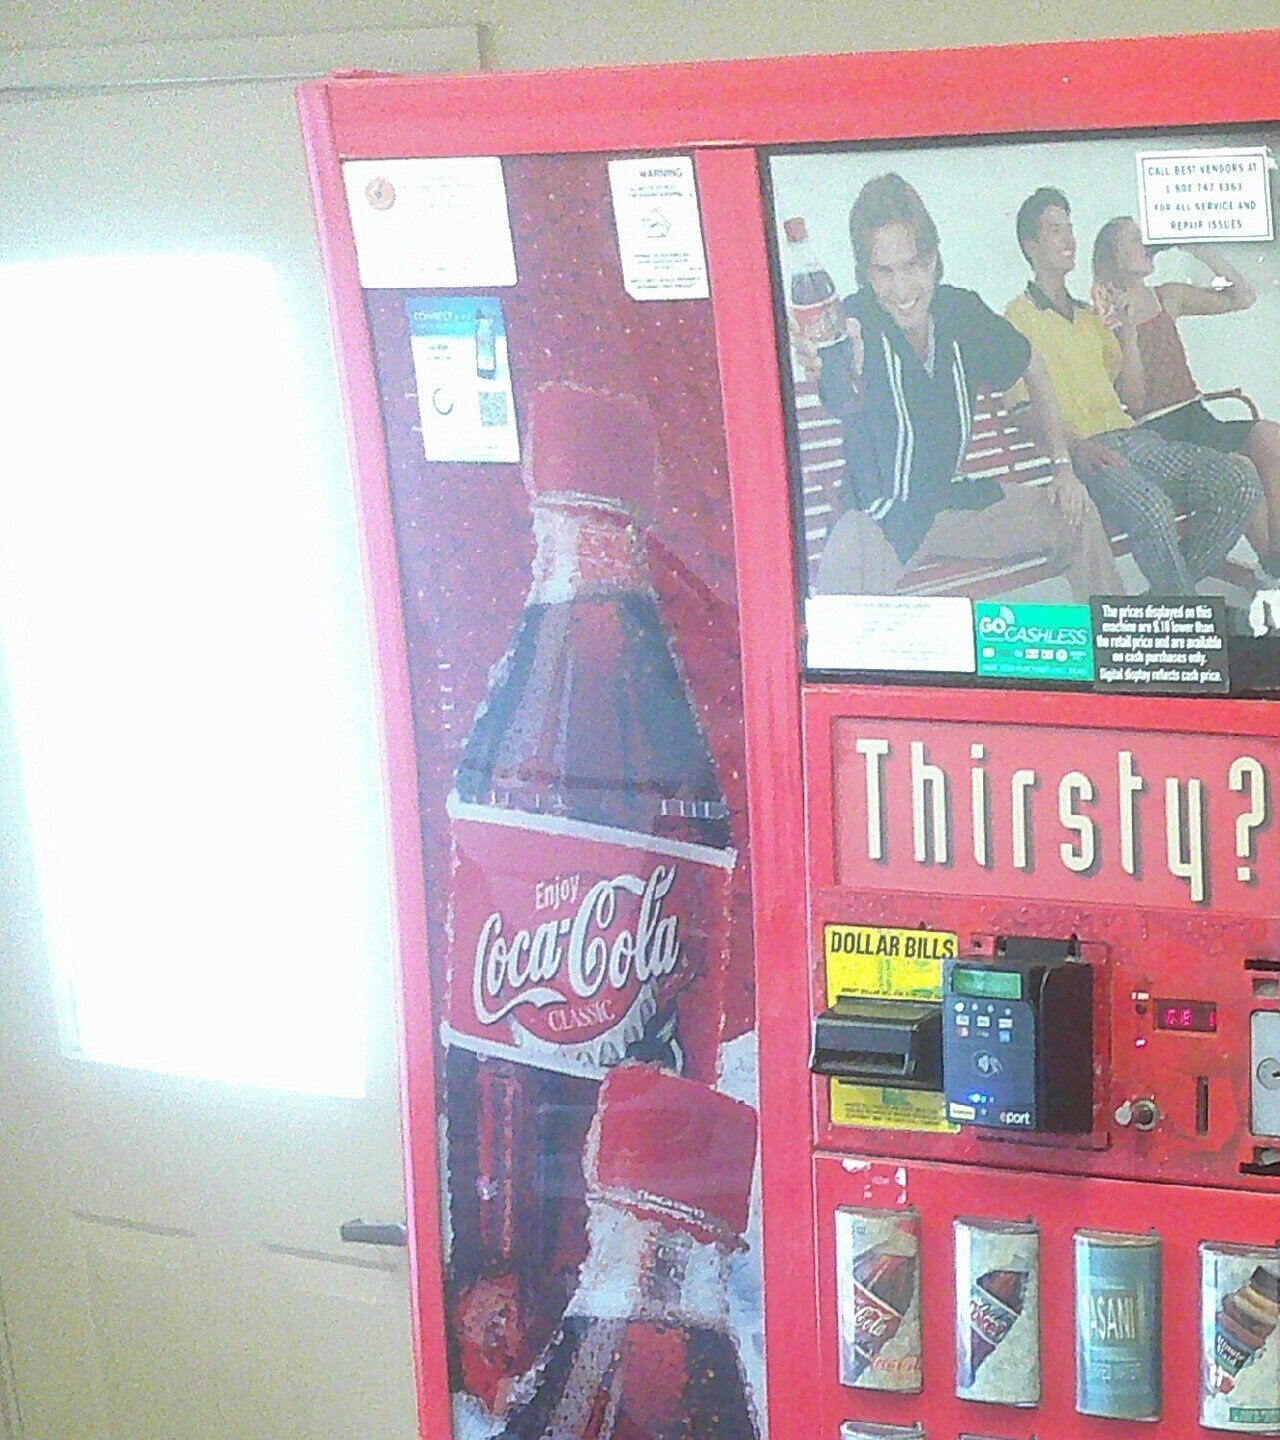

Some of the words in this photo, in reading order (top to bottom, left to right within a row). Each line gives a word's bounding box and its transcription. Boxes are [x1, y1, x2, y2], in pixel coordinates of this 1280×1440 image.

[1148, 167, 1169, 175] CALL
[1174, 165, 1196, 175] BEST
[1200, 164, 1244, 174] VENDORS
[1239, 201, 1256, 209] AND
[1171, 221, 1202, 230] REPAIR
[1208, 220, 1242, 228] ISSUES
[979, 616, 1006, 633] GO
[1005, 626, 1087, 646] CASHLESS
[856, 737, 1266, 903] Thirsty?
[535, 873, 580, 910] Enjoy
[473, 864, 680, 1025] Coca-Cola
[831, 930, 900, 957] DOLLAR
[905, 936, 956, 960] BILLS
[548, 1000, 616, 1032] CLASSIC
